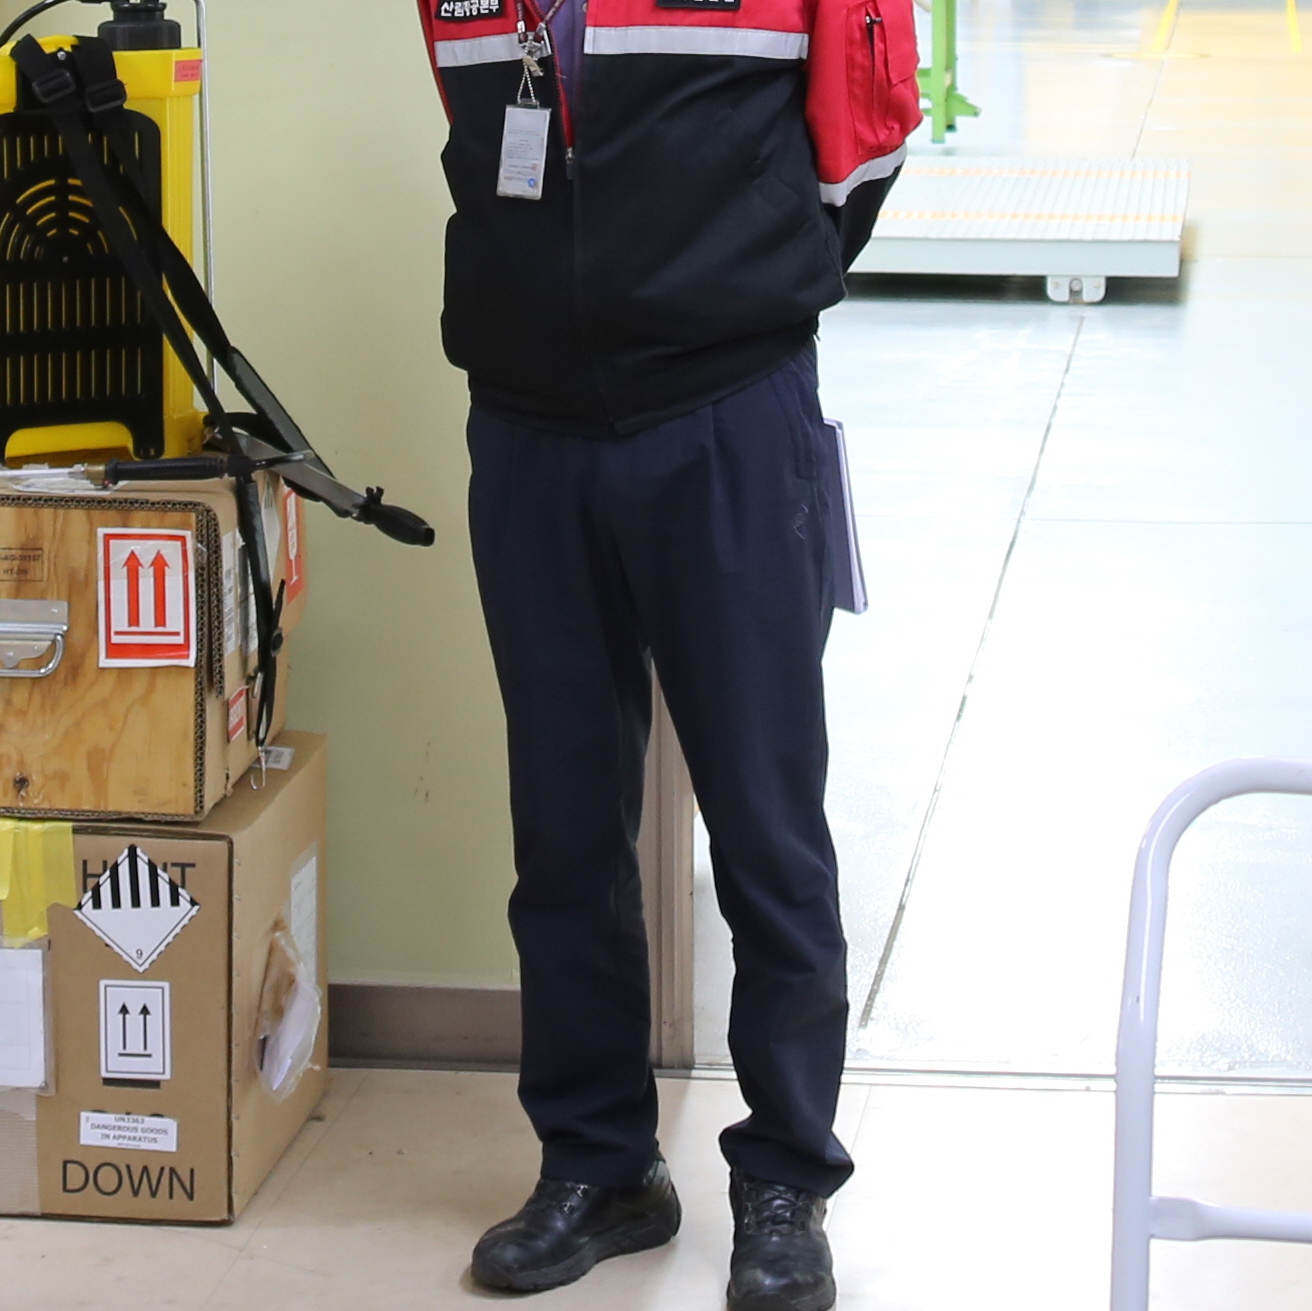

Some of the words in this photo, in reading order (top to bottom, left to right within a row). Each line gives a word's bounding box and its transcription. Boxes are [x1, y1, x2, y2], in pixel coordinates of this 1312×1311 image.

[82, 859, 196, 894] HT
[135, 948, 144, 960] 9
[90, 1122, 139, 1134] DANGEROUS
[140, 1126, 169, 1136] GOODS
[112, 1134, 159, 1144] APPARATUS
[62, 1159, 195, 1202] DOWN
